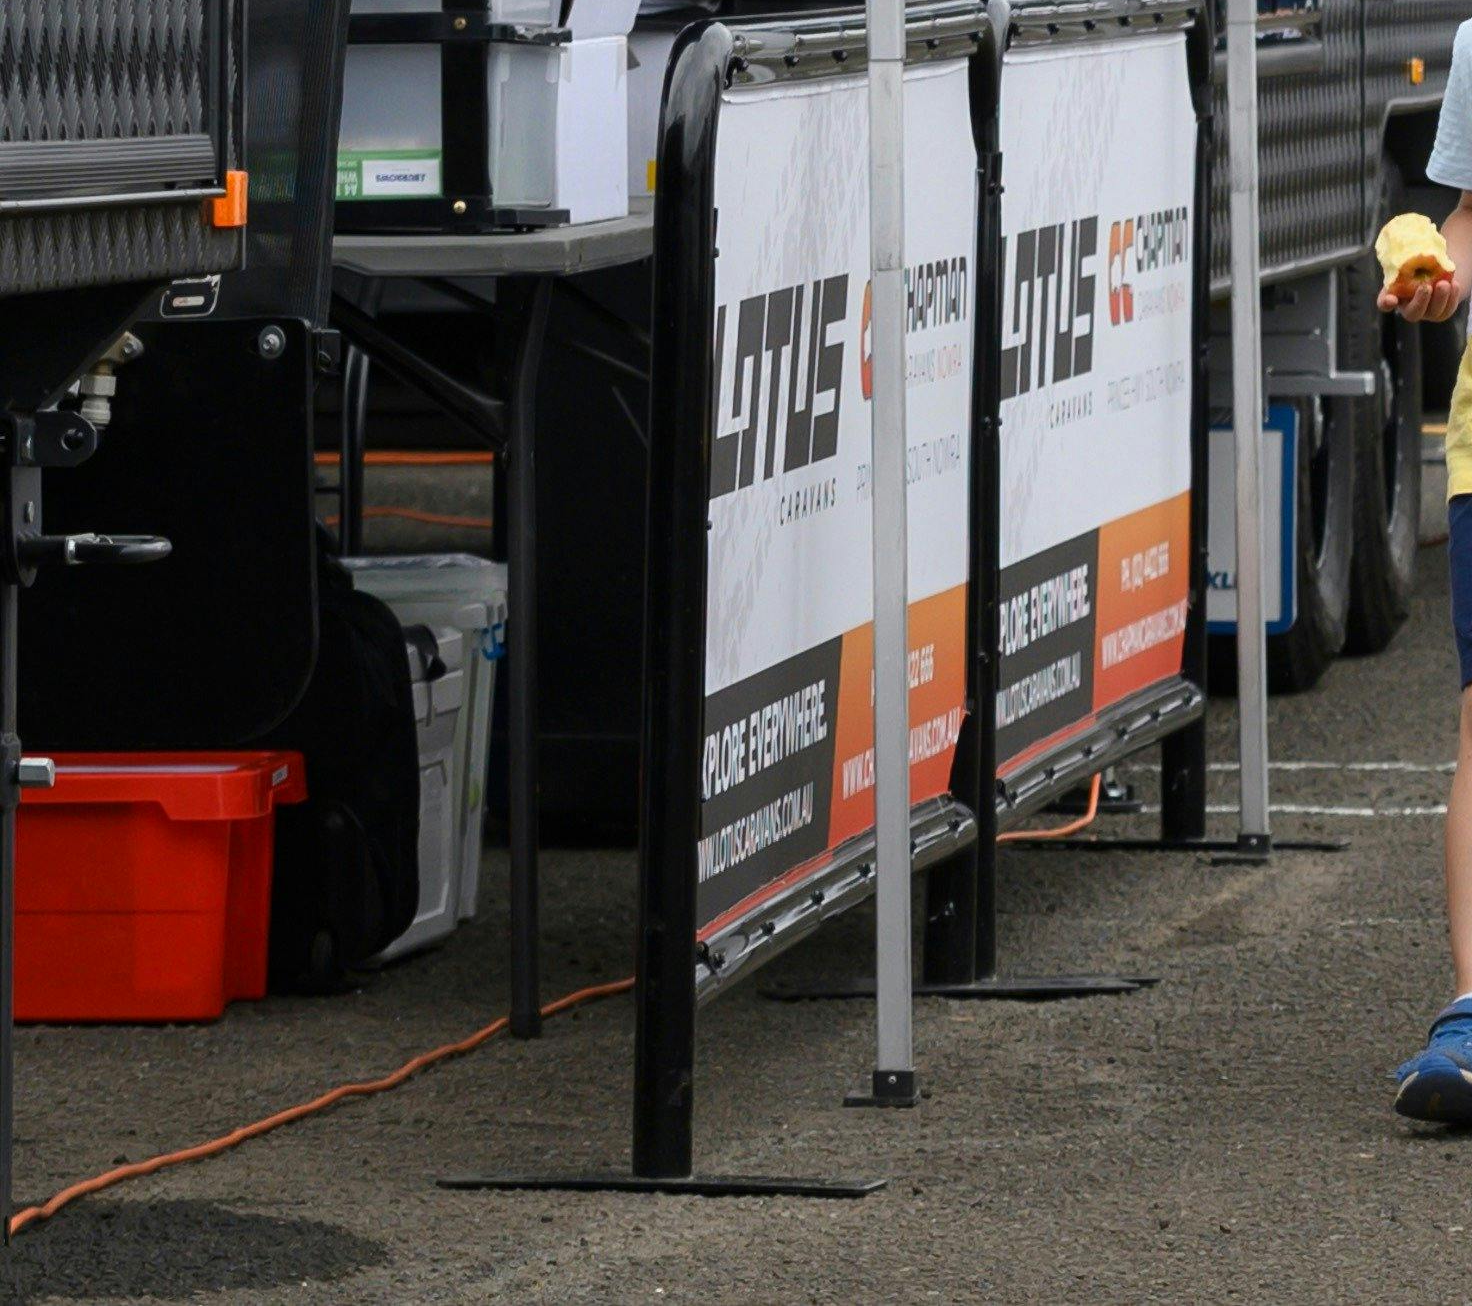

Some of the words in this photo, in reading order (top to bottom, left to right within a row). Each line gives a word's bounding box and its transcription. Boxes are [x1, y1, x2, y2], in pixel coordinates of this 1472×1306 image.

[1136, 205, 1188, 274] CHAPMAN
[903, 256, 967, 334] HAPMAN
[1000, 215, 1098, 402] LOTUS
[709, 273, 849, 500] LOTUS
[780, 477, 837, 527] CARAVANS
[998, 591, 1029, 657] PLORE
[749, 678, 828, 777] EVERYWHERE.
[697, 780, 814, 884] WW.LOTUSCARAVANS.COM.AU
